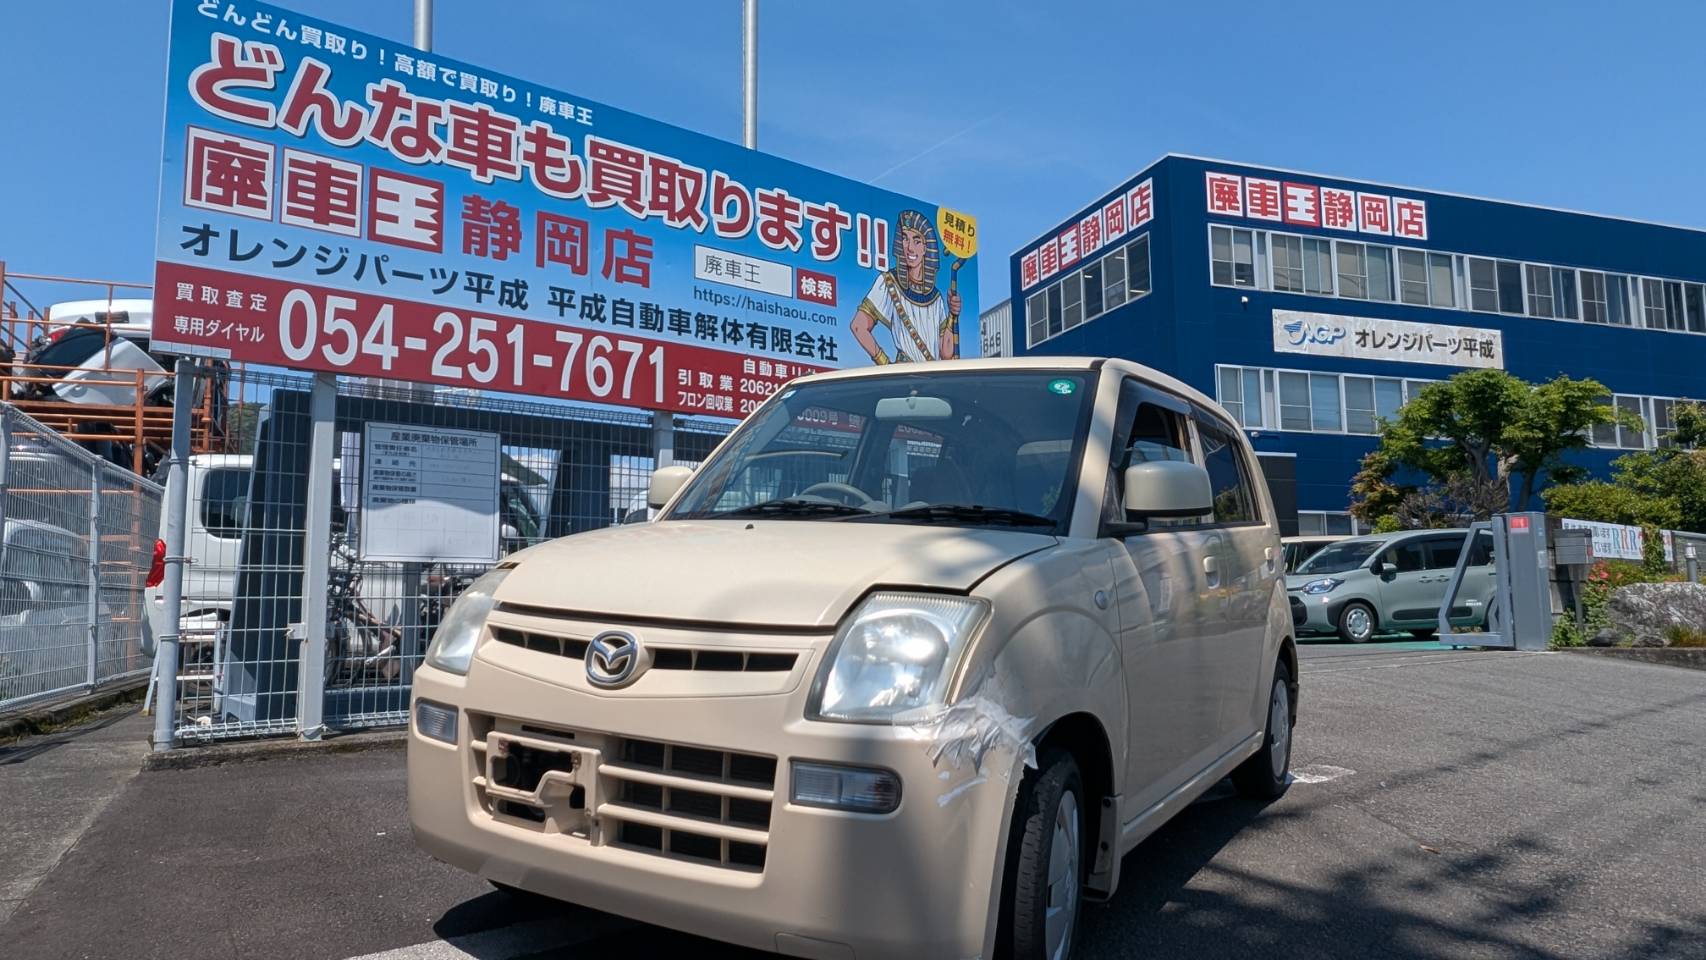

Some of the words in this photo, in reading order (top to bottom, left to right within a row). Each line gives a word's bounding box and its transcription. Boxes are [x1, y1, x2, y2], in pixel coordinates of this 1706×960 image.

[188, 32, 890, 271] どんな車も買取ります!!
[943, 211, 975, 237] 見積り
[1209, 176, 1425, 237] 廃車王静岡店
[1022, 183, 1152, 289] 廃車王静岡店
[175, 282, 268, 312] 買取査定
[180, 223, 529, 311] オレンジパーツ平成
[546, 285, 838, 362] 平成自動車解体有限会社
[704, 254, 761, 285] 廃車王
[801, 275, 833, 300] 検索
[694, 286, 837, 327] https://haishaou.com
[173, 315, 265, 342] 専用ダイヤル
[279, 288, 664, 403] 054-251-7671
[1355, 329, 1496, 360] オレンジパーツ平成
[677, 368, 734, 392] 引取業
[677, 391, 734, 413] フロン回収業
